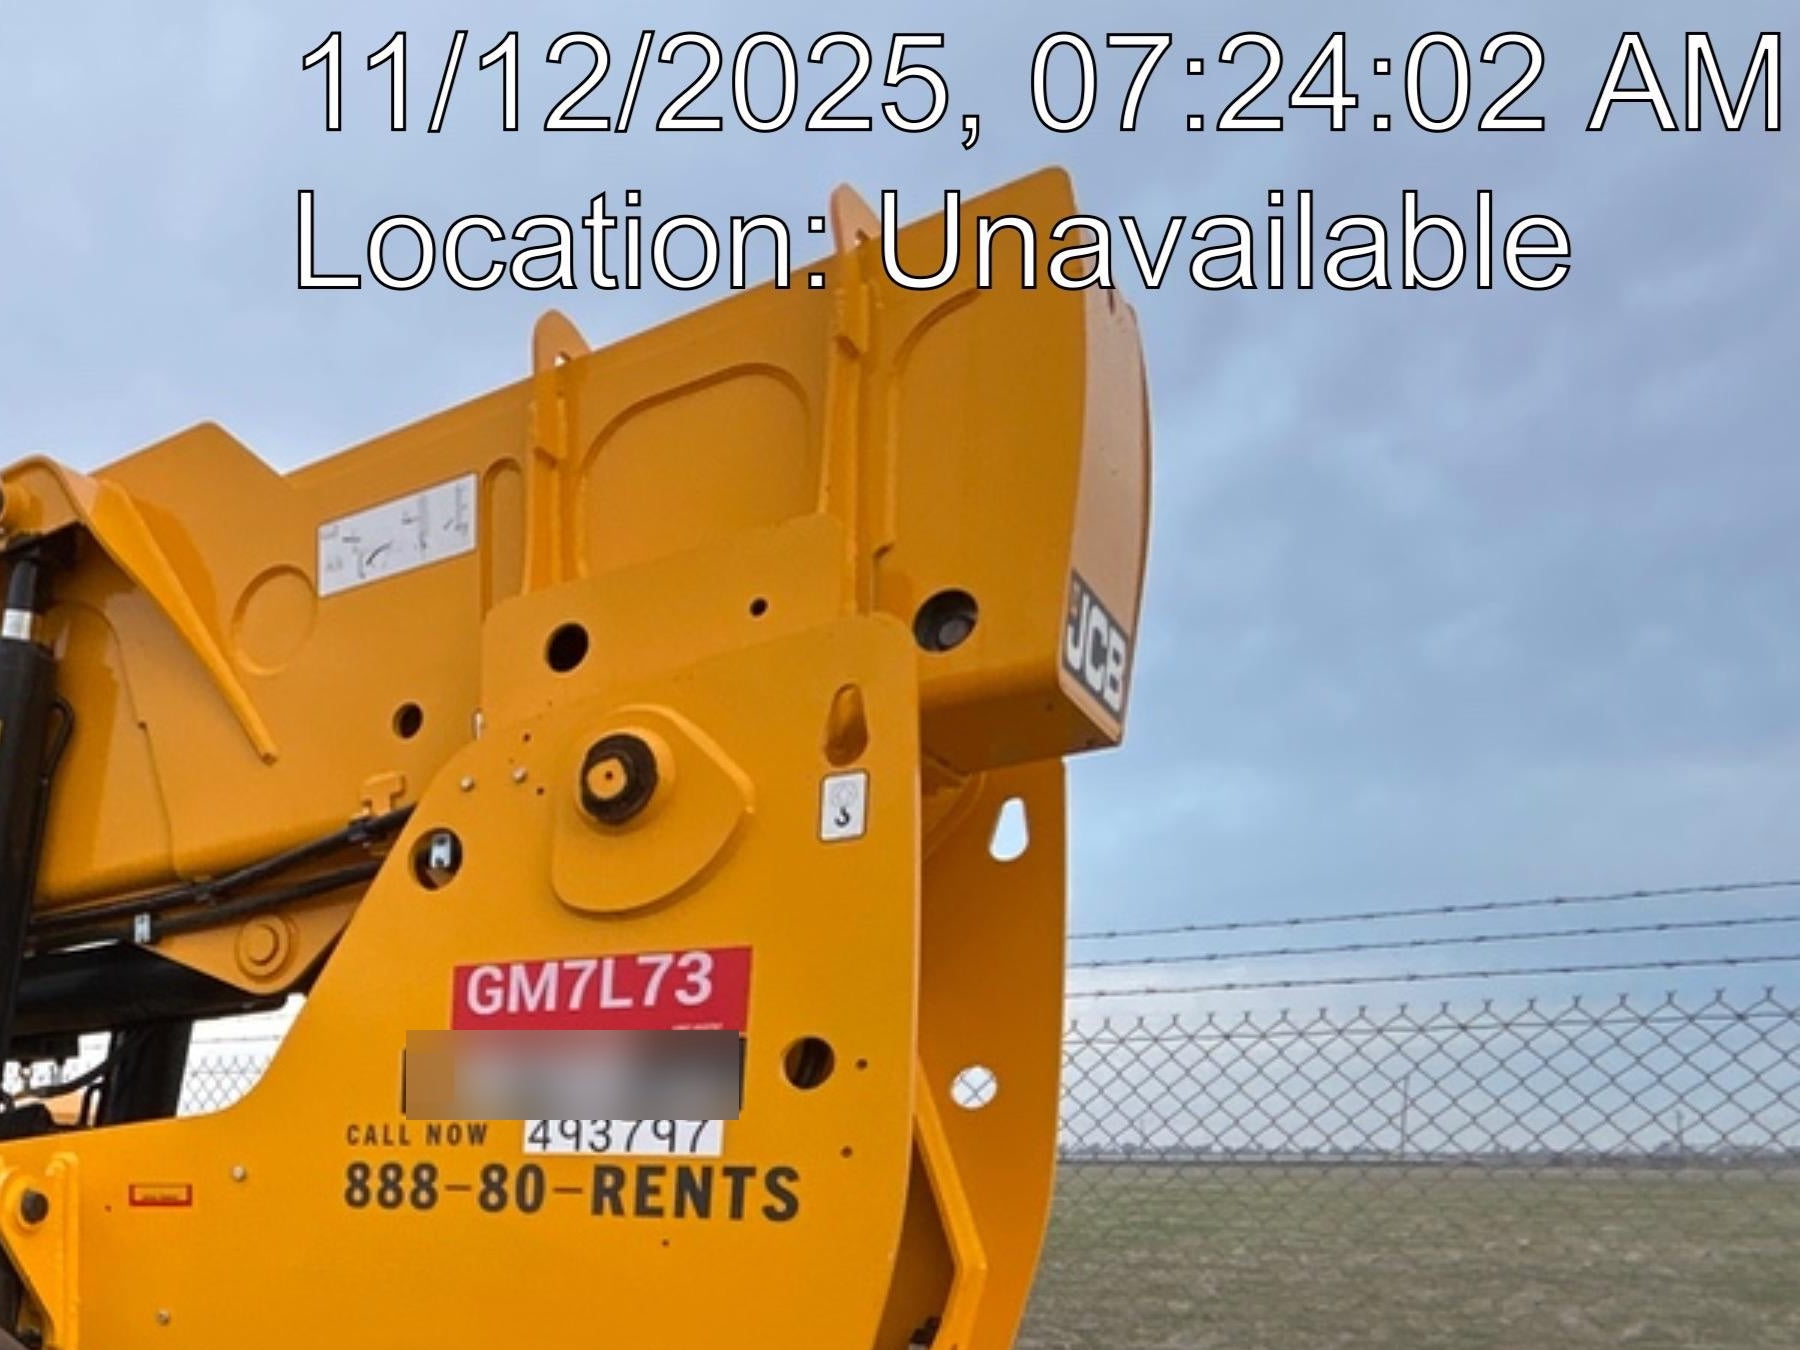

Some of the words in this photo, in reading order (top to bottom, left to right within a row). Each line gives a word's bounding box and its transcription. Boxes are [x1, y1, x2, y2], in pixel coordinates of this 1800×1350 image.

[1066, 578, 1126, 713] JCB
[466, 950, 714, 1015] GM7L73
[346, 1123, 410, 1146] CALL
[425, 1123, 488, 1146] NOW
[526, 1120, 708, 1153] 493797
[343, 1161, 800, 1222] 888-80-RENTS
